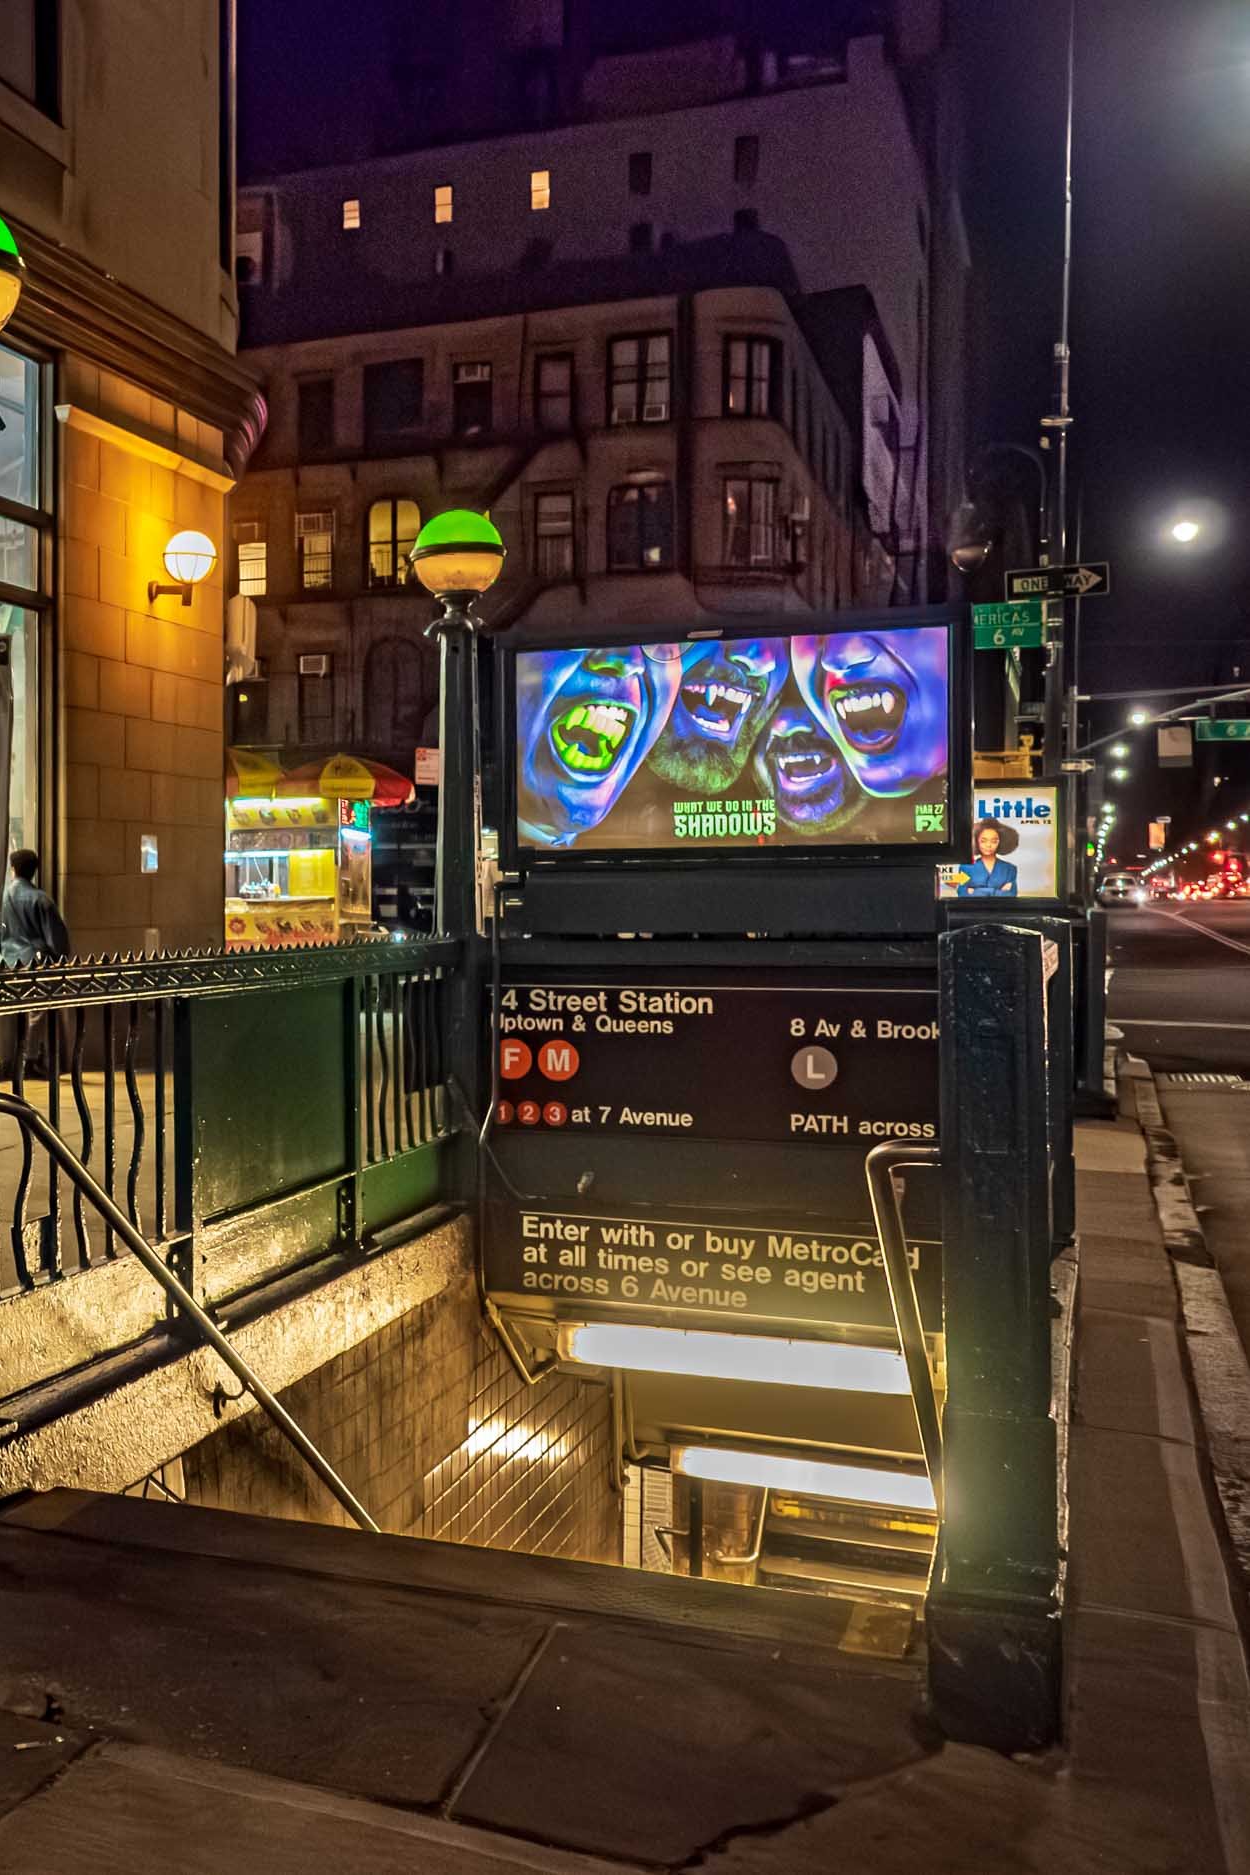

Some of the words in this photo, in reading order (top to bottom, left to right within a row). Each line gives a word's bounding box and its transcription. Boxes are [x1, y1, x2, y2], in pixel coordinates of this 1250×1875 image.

[993, 629, 1005, 645] 6
[673, 801, 704, 814] WHAT
[706, 801, 723, 812] WE
[725, 800, 739, 812] DO
[742, 799, 752, 812] IN
[755, 799, 775, 812] THE
[978, 797, 1051, 819] Little
[674, 812, 776, 838] SHADOWS
[915, 815, 944, 833] FX
[490, 989, 518, 1011] 4
[529, 989, 608, 1012] Street
[618, 990, 713, 1014] Station
[572, 1014, 586, 1032] &
[595, 1014, 674, 1034] Queens
[790, 1018, 806, 1037] 8
[814, 1019, 841, 1038] Av
[850, 1020, 867, 1038] &
[504, 1048, 521, 1070] F
[546, 1048, 570, 1072] M
[806, 1054, 826, 1079] L
[571, 1107, 591, 1124] at
[599, 1106, 612, 1123] 7
[619, 1107, 694, 1127] Avenue
[790, 1114, 848, 1134] PATH
[858, 1120, 936, 1138] across
[522, 1215, 590, 1242] Enter
[600, 1223, 655, 1248] with
[666, 1232, 695, 1251] or
[706, 1230, 756, 1260] buy
[768, 1235, 920, 1271] MetroCad
[523, 1243, 548, 1264] at
[558, 1245, 587, 1267] all
[597, 1248, 670, 1275] times
[681, 1259, 710, 1278] or
[721, 1263, 773, 1284] see
[784, 1268, 866, 1293] agent
[523, 1270, 610, 1295] across
[621, 1275, 639, 1298] 6
[651, 1278, 748, 1308] Avenue
